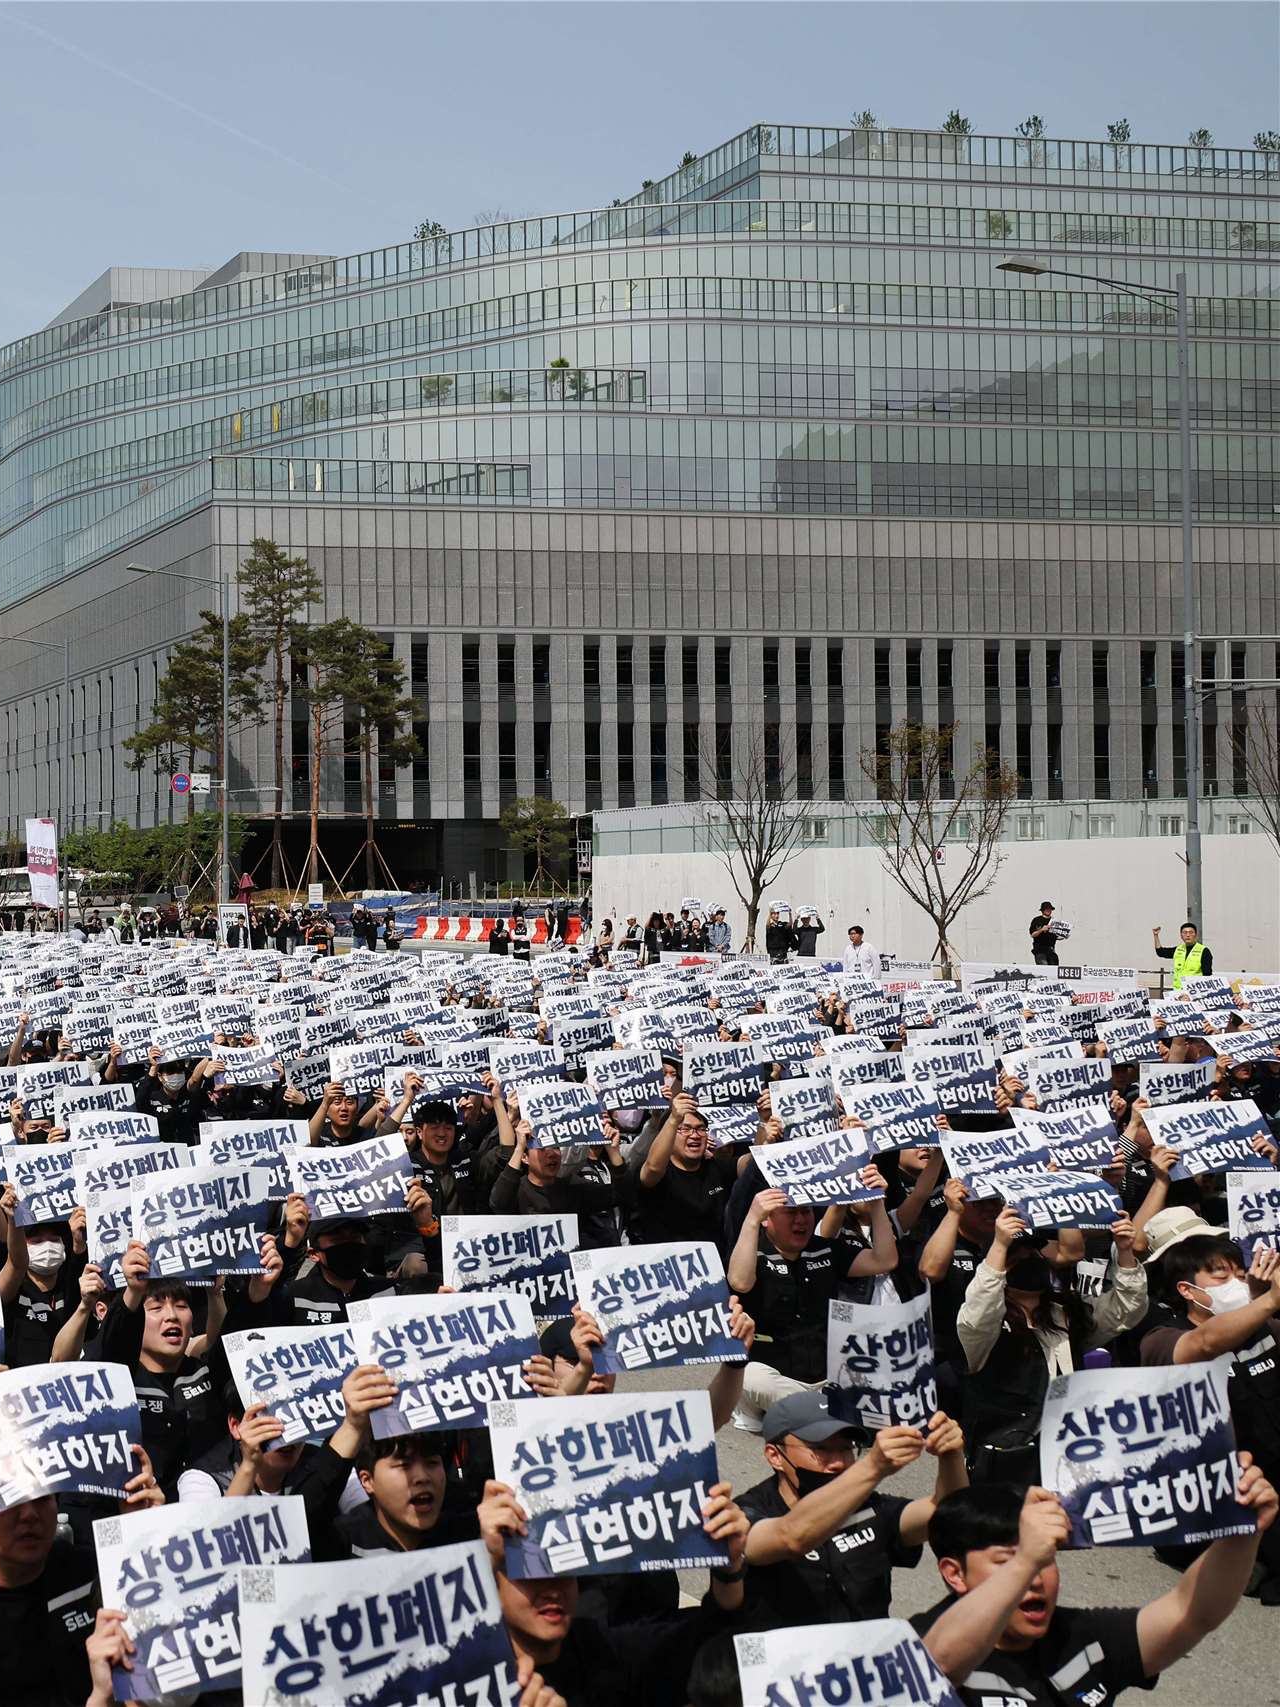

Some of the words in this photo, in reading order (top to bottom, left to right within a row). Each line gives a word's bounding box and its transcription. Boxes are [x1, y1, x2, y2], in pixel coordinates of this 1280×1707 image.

[1059, 968, 1080, 978] NSEU
[1186, 978, 1225, 997] 상한폐지
[66, 1018, 109, 1034] 상한폐지
[355, 1012, 402, 1034] 상한폐지
[747, 1016, 805, 1040] 상한폐지
[855, 1004, 894, 1024] 상한폐지
[1156, 1003, 1196, 1022] 상한폐지
[1166, 1020, 1206, 1036] 실현하자
[156, 1024, 202, 1046] 상한폐지
[558, 1022, 613, 1046] 상한폐지
[1102, 1021, 1150, 1044] 상한폐지
[1215, 1030, 1265, 1051] 상한폐지
[495, 1051, 557, 1074] 상한폐지
[688, 1046, 755, 1077] 상한폐지
[911, 1047, 984, 1082] 상한폐지
[1111, 1040, 1159, 1063] 실현하자
[22, 1065, 81, 1091] 상한폐지
[224, 1065, 271, 1084] 실현하자
[423, 1072, 482, 1090] 실현하자
[592, 1055, 655, 1081] 상한폐지
[1036, 1065, 1104, 1095] 상한폐지
[1145, 1066, 1207, 1097] 상한폐지
[526, 1088, 591, 1116] 상한폐지
[601, 1082, 663, 1108] 실현하자
[696, 1076, 761, 1106] 실현하자
[854, 1085, 925, 1119] 상한폐지
[937, 1081, 995, 1109] 현하자
[536, 1114, 603, 1145] 실현하자
[872, 1115, 938, 1150] 실현하자
[1158, 1105, 1238, 1144] 상한폐지
[209, 1126, 297, 1163] 상한폐지
[766, 1134, 853, 1177] 상한폐지
[950, 1135, 1028, 1167] 상한폐지
[1183, 1132, 1263, 1174] 실현하자
[84, 1147, 179, 1192] 상한폐지
[297, 1140, 392, 1182] 상한폐지
[141, 1173, 251, 1226] 상한폐지
[314, 1171, 413, 1217] 실현하자
[787, 1168, 866, 1204] 실현하자
[1027, 1189, 1118, 1227] 실현하자
[154, 1223, 268, 1276] 실현하자
[453, 1220, 565, 1273] 상한폐지
[591, 1248, 709, 1315] 상한폐지
[307, 1312, 331, 1323] 투쟁
[370, 1300, 516, 1368] 상한폐지
[616, 1302, 731, 1370] 실현하자
[245, 1329, 353, 1391] 상한폐지
[1249, 1358, 1275, 1377] SELU
[183, 1381, 211, 1399] SELU
[1057, 1372, 1220, 1462] 상한폐지
[511, 1400, 692, 1492] 상한폐지
[1083, 1451, 1239, 1544] 실현하자
[540, 1480, 712, 1573] 실현하자
[833, 1527, 876, 1553] SELU
[116, 1505, 288, 1608] 상한폐지
[66, 1613, 94, 1632] SEL
[262, 1553, 487, 1697] 상한폐지
[146, 1610, 242, 1694] 실현
